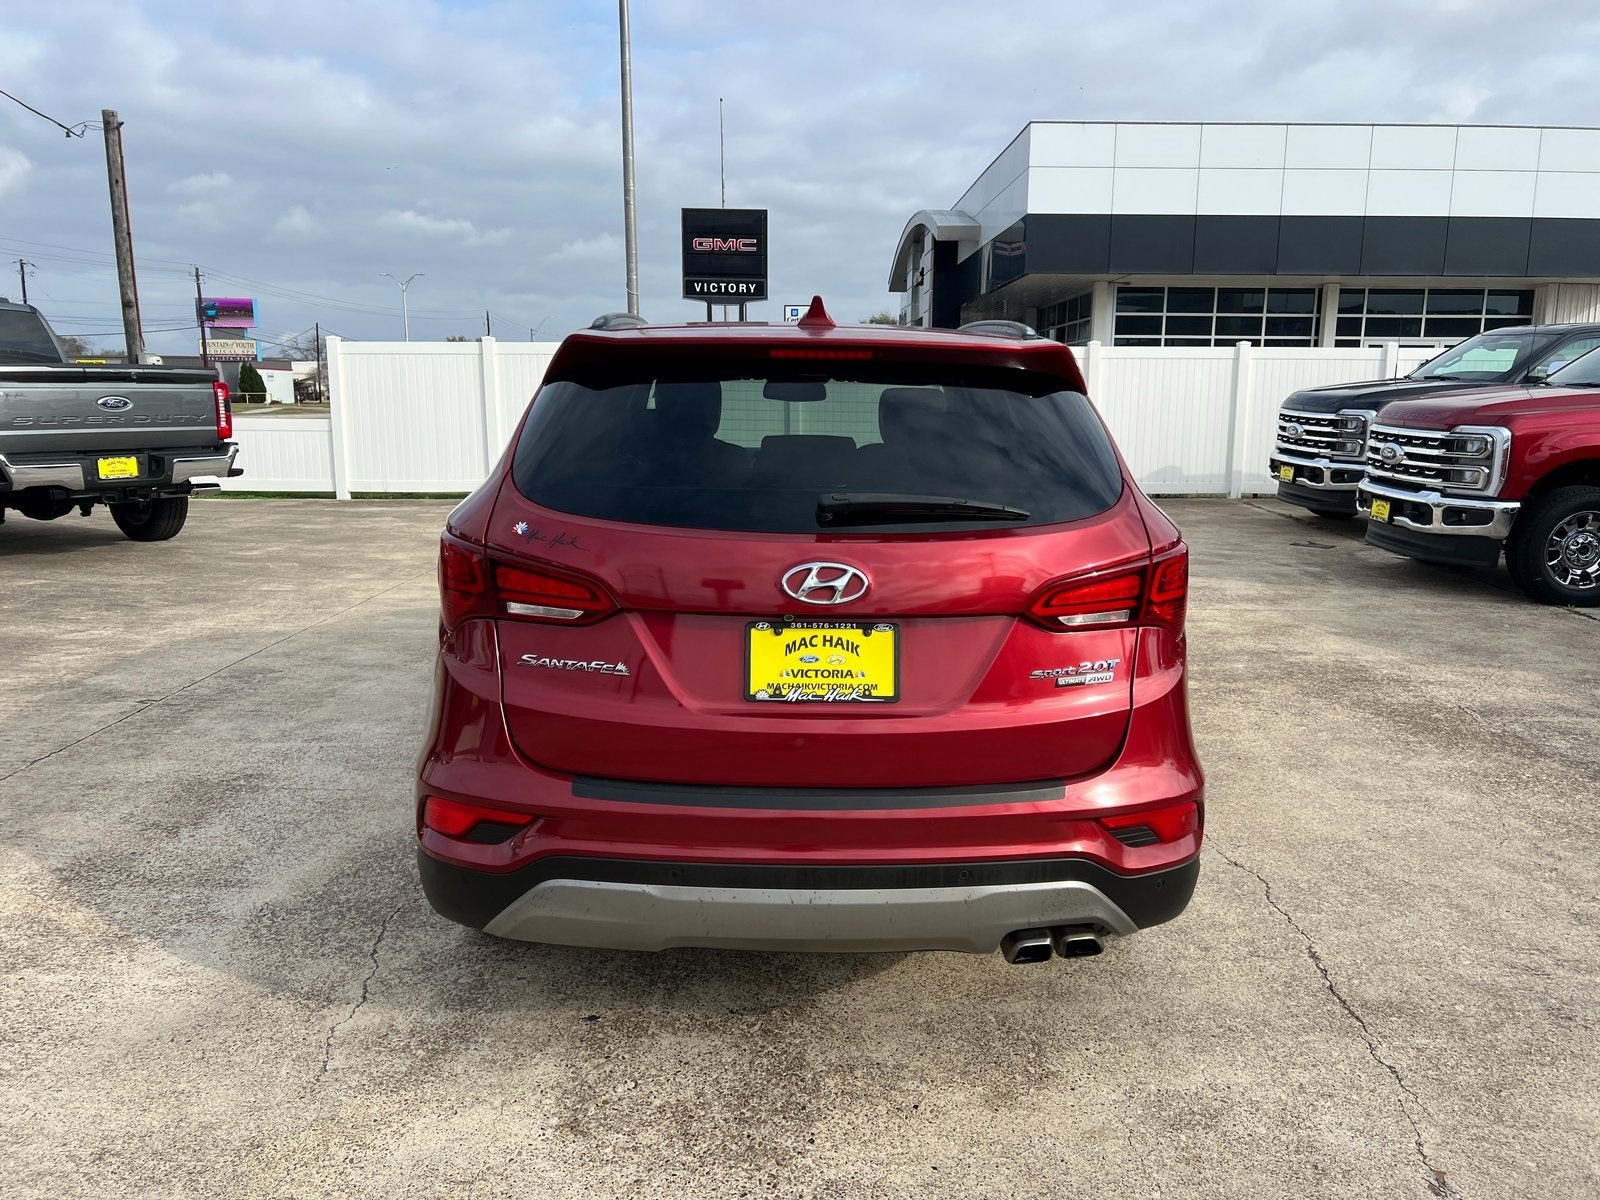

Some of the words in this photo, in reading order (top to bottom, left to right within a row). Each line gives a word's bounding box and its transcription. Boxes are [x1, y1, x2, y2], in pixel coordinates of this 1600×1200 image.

[692, 238, 757, 251] GMC
[694, 282, 757, 293] VICTORY
[106, 399, 124, 407] Ford
[13, 415, 125, 426] SUPER
[134, 414, 207, 424] DUTY
[784, 634, 819, 657] MAC
[822, 634, 860, 657] HAIK
[801, 655, 818, 664] Ford
[790, 668, 854, 679] VICTORIA
[1058, 677, 1086, 685] ULTIMATE
[1087, 674, 1112, 683] AWD
[785, 686, 822, 702] Mac
[823, 686, 872, 702] Haik
